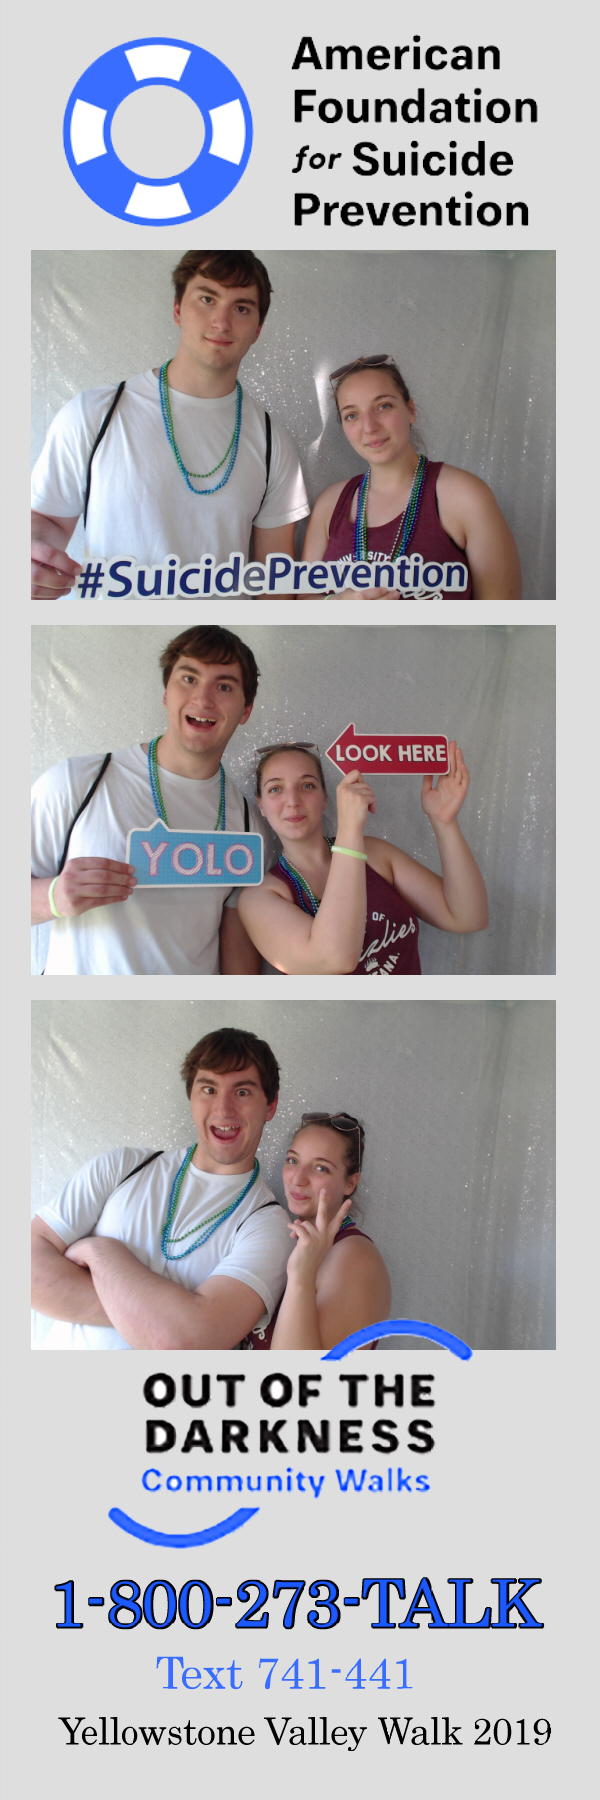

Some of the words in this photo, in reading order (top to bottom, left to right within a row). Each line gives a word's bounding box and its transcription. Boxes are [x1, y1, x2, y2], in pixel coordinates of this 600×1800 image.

[78, 556, 465, 598] #SuicidePrevention
[336, 744, 393, 762] LOOK
[398, 744, 447, 762] HERE
[141, 841, 254, 876] YOLO
[372, 912, 385, 921] OF
